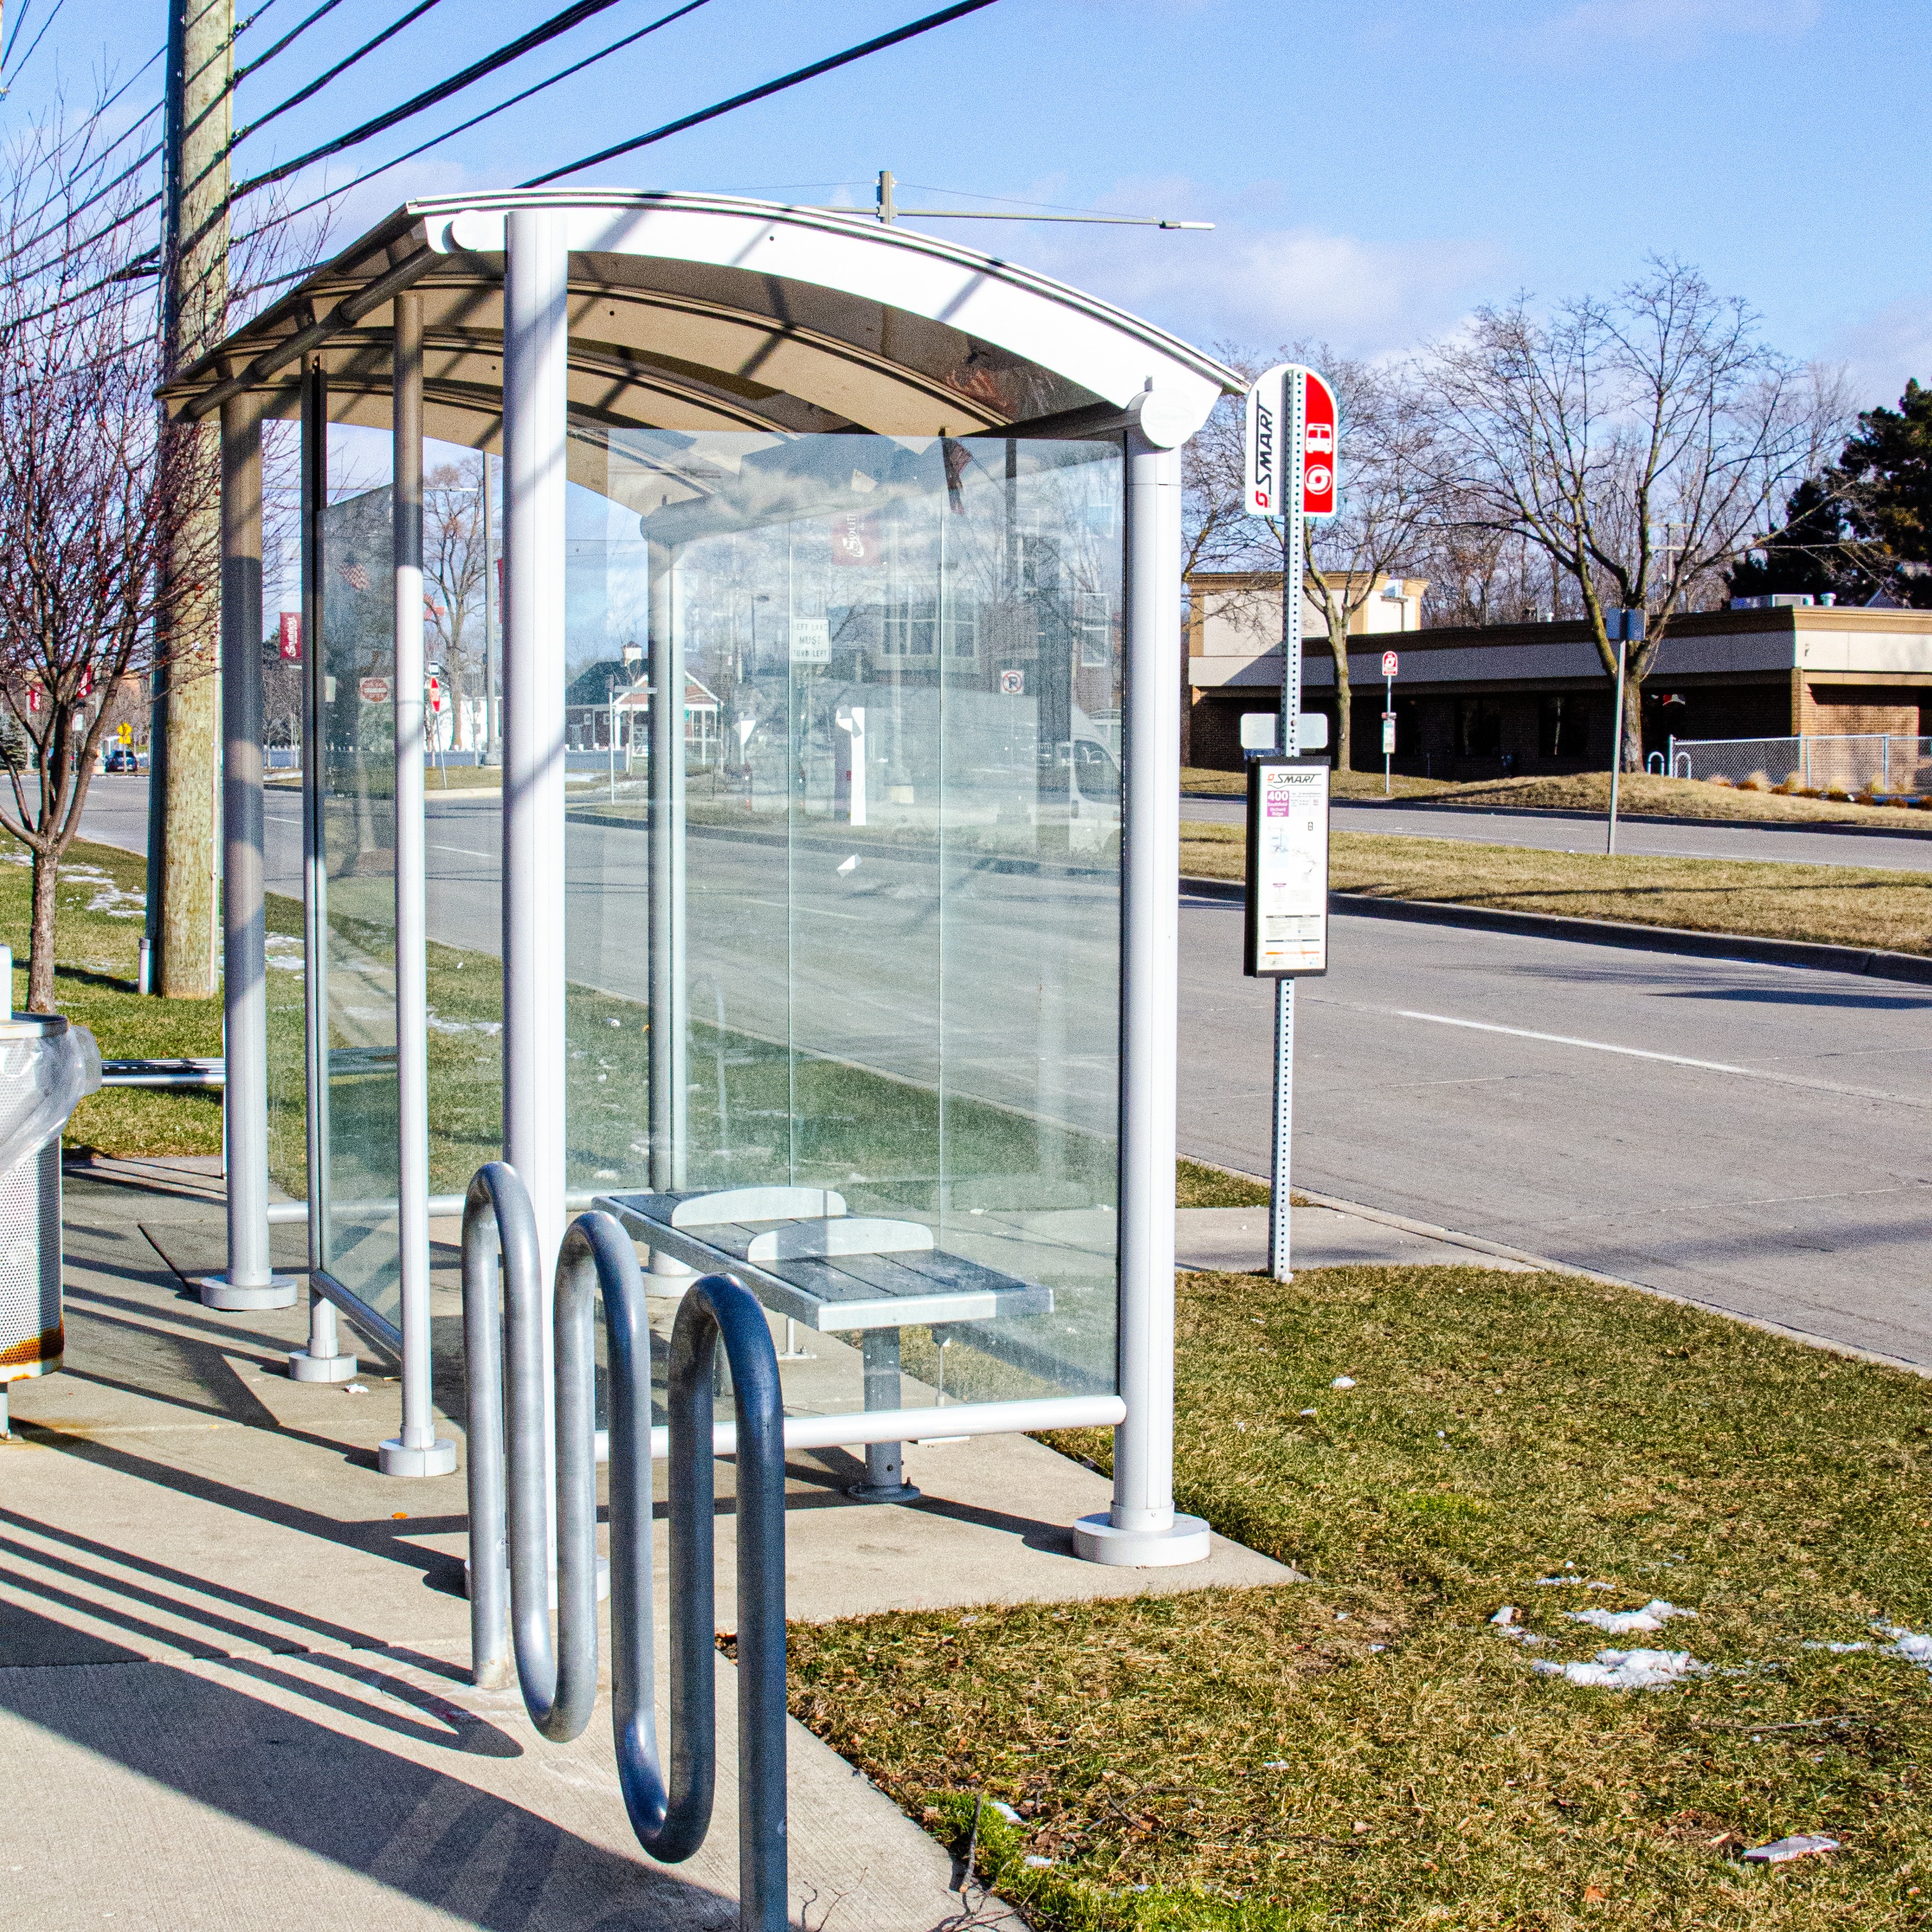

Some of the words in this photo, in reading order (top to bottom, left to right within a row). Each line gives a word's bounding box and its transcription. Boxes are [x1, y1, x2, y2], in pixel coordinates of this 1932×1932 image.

[1255, 389, 1273, 495] SMART
[799, 636, 822, 645] MUST
[1273, 774, 1322, 783] SMART
[1267, 791, 1289, 801] 400
